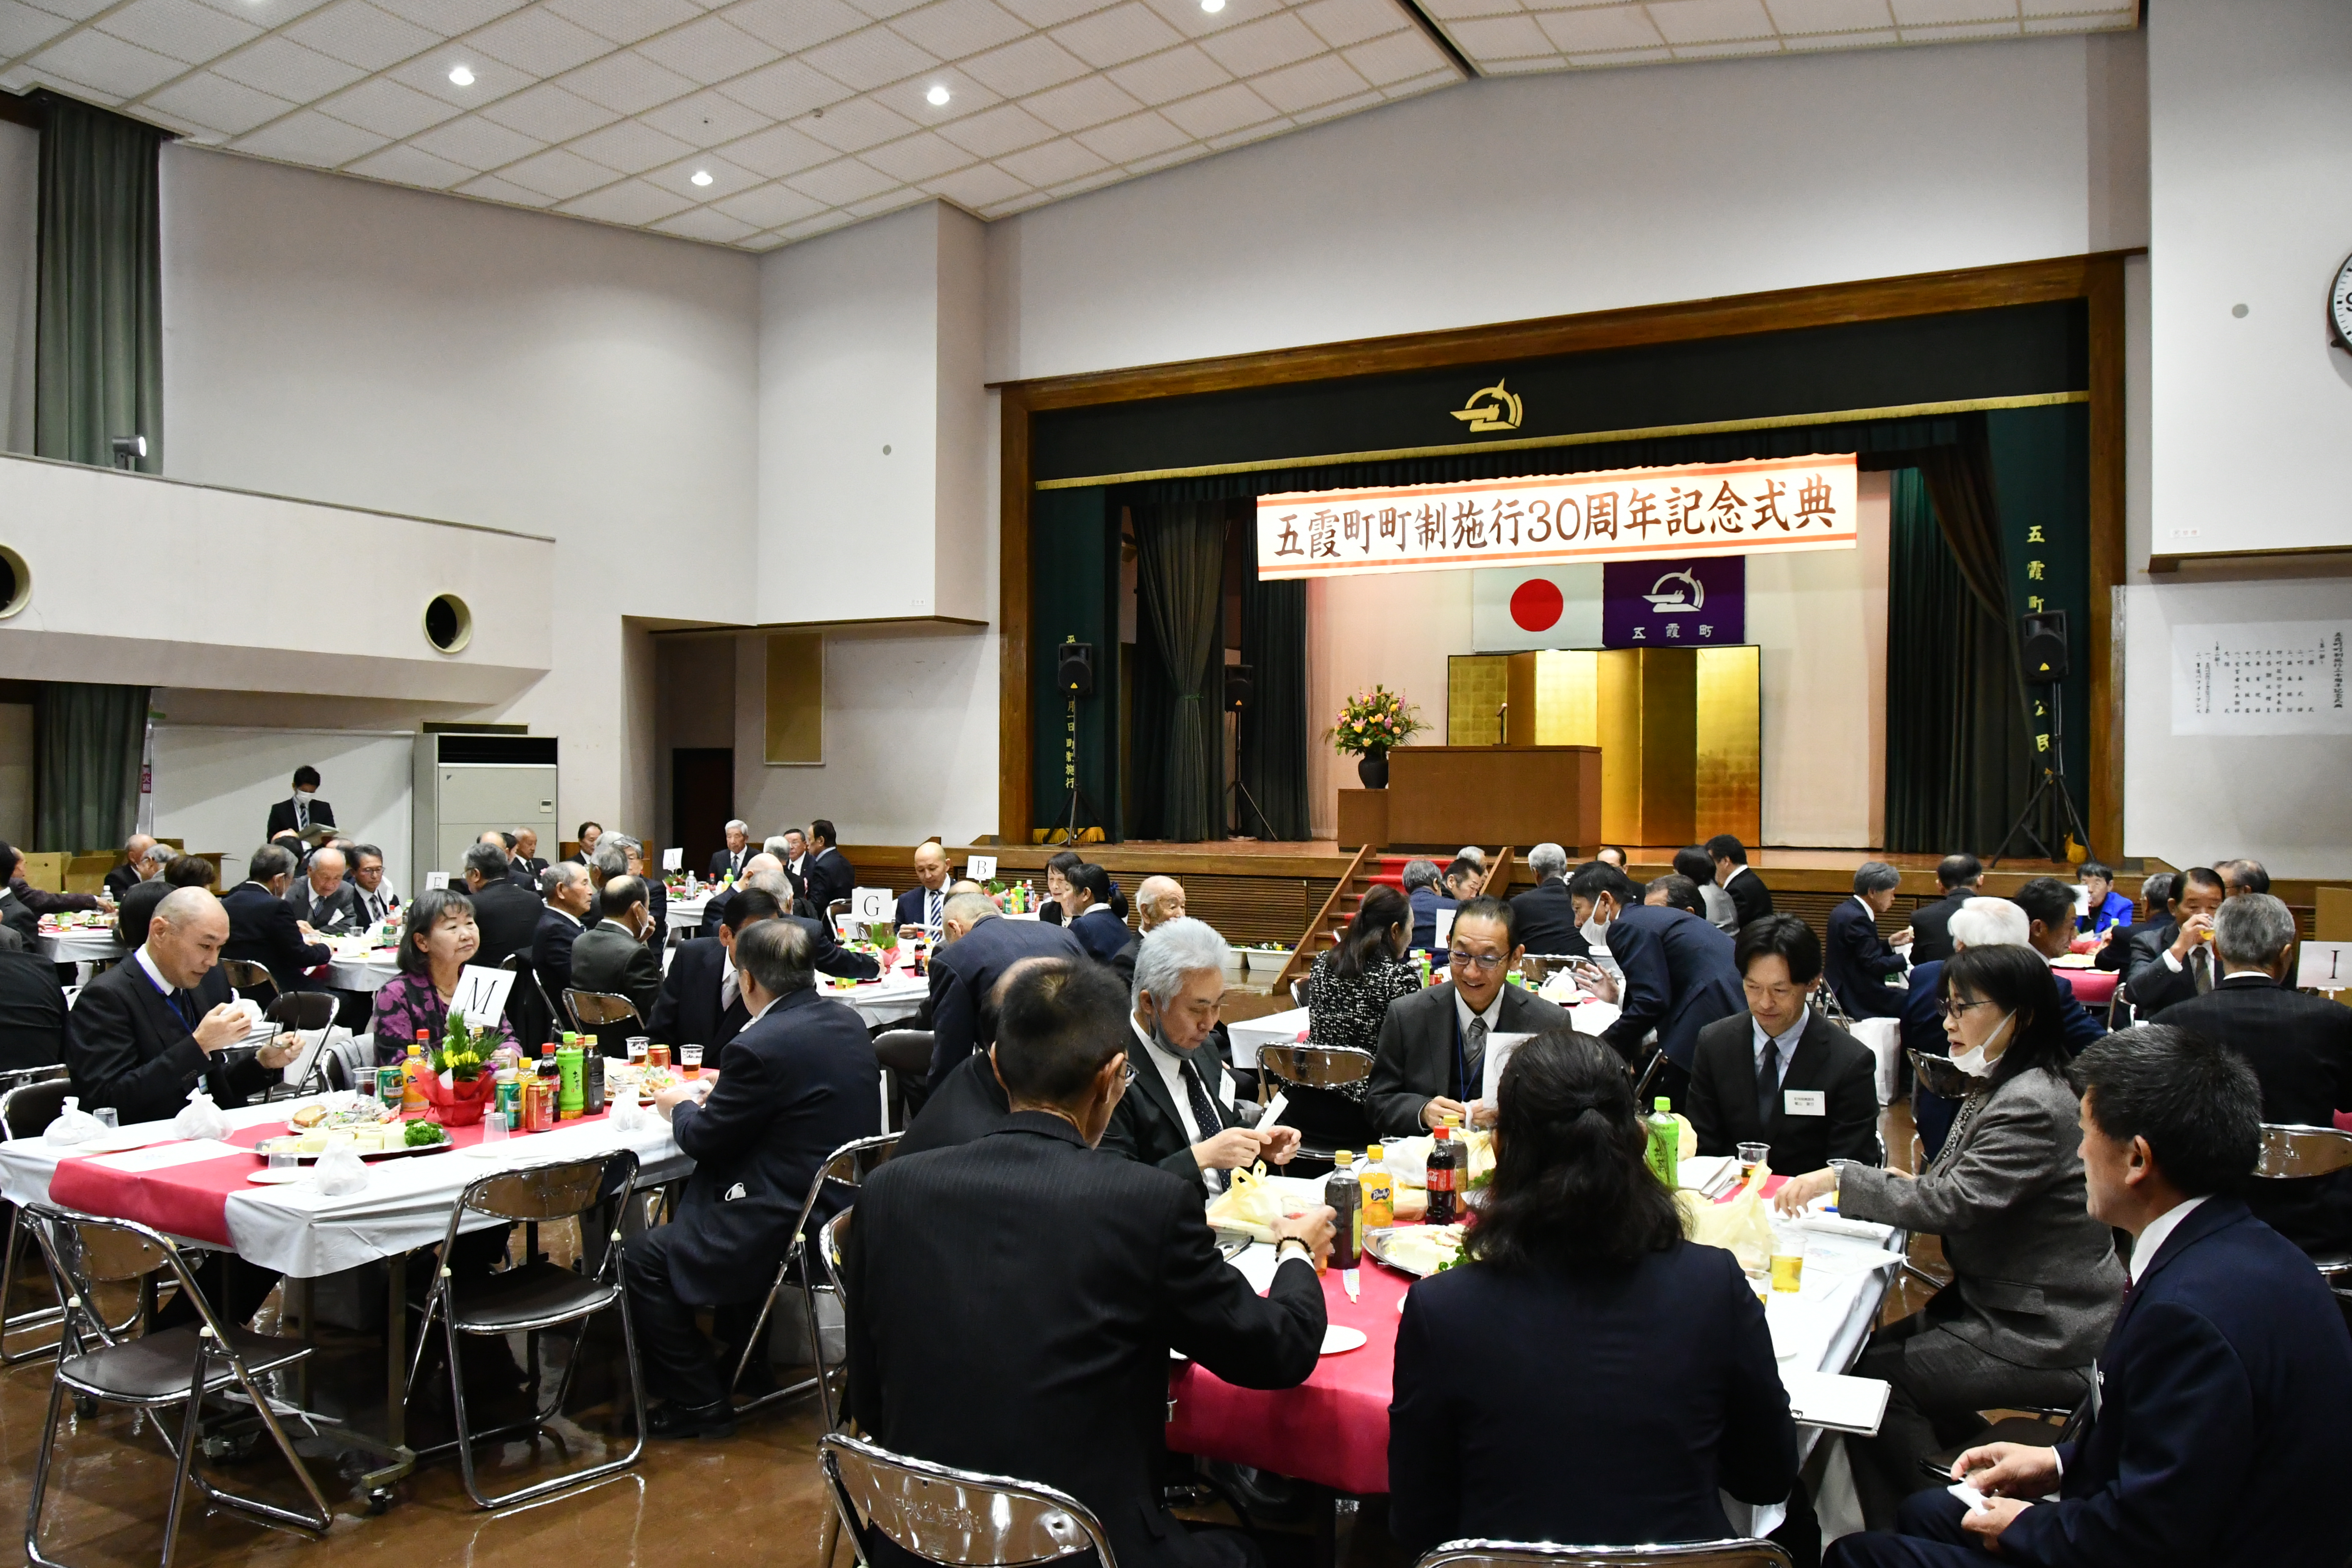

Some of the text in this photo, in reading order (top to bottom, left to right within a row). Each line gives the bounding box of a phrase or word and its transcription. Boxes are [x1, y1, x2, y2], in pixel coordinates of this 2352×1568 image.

[1276, 473, 1836, 558] 五霞町町制施行30周年記念式典
[1632, 623, 1713, 640] 五霞町
[668, 853, 676, 866] A
[977, 860, 987, 875] B
[863, 895, 880, 917] G
[2328, 950, 2341, 980] I
[462, 977, 498, 1015] M
